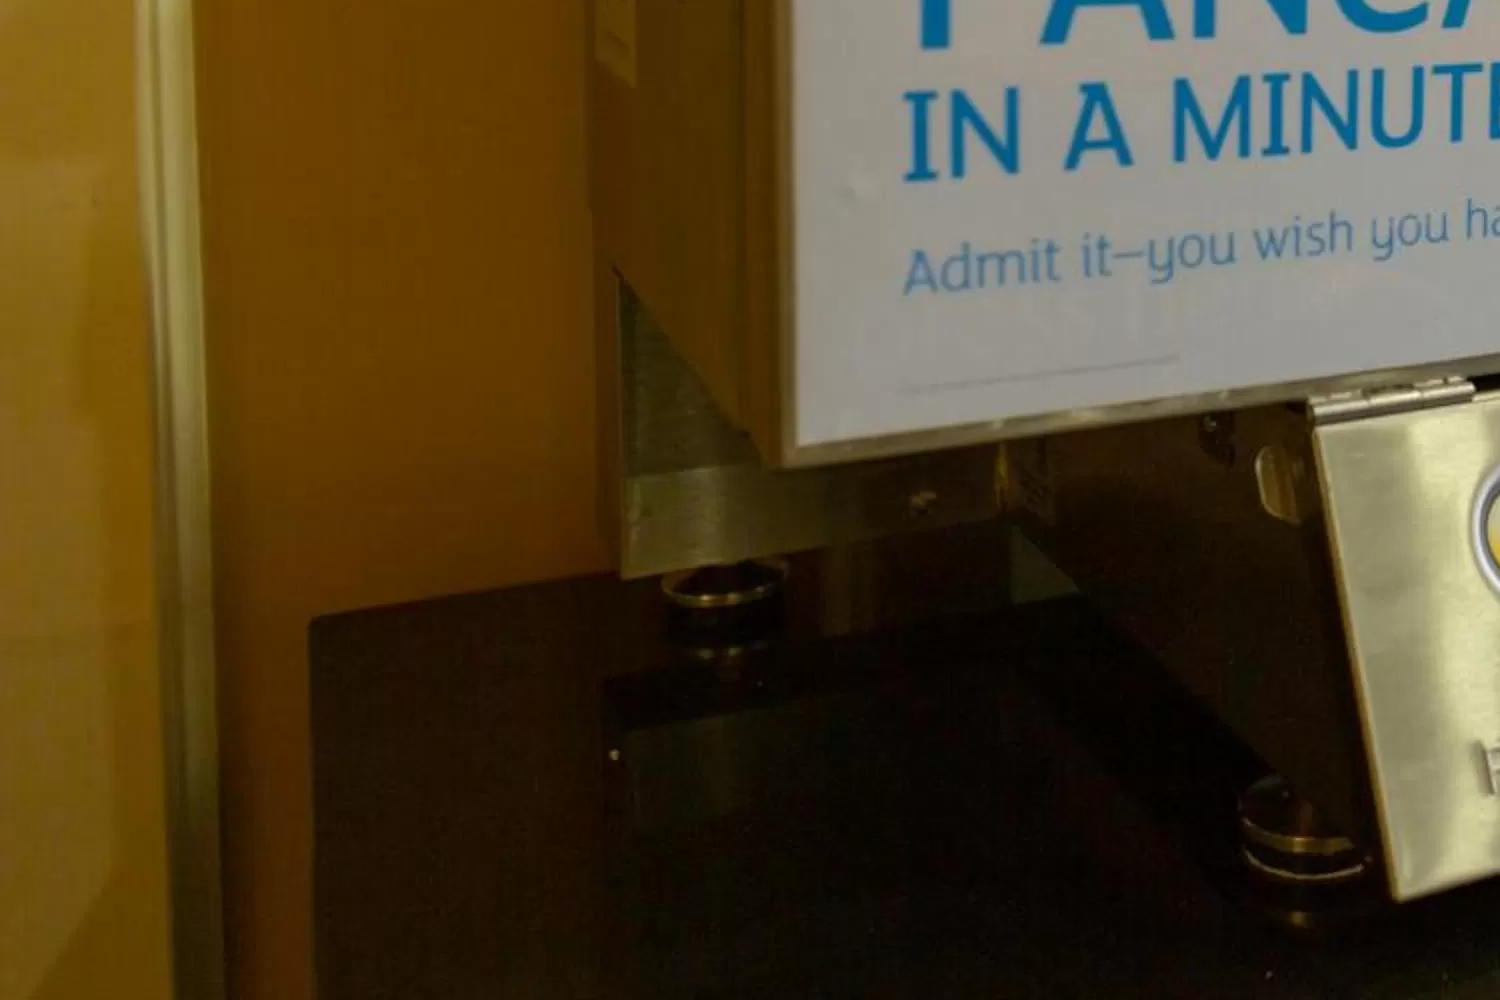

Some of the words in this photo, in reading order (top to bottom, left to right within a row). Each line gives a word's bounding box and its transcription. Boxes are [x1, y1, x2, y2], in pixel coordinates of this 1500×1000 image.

[902, 86, 1020, 182] IN
[1063, 81, 1134, 172] A
[902, 240, 1062, 297] Admit
[1252, 210, 1355, 261] wish
[1370, 213, 1450, 262] you
